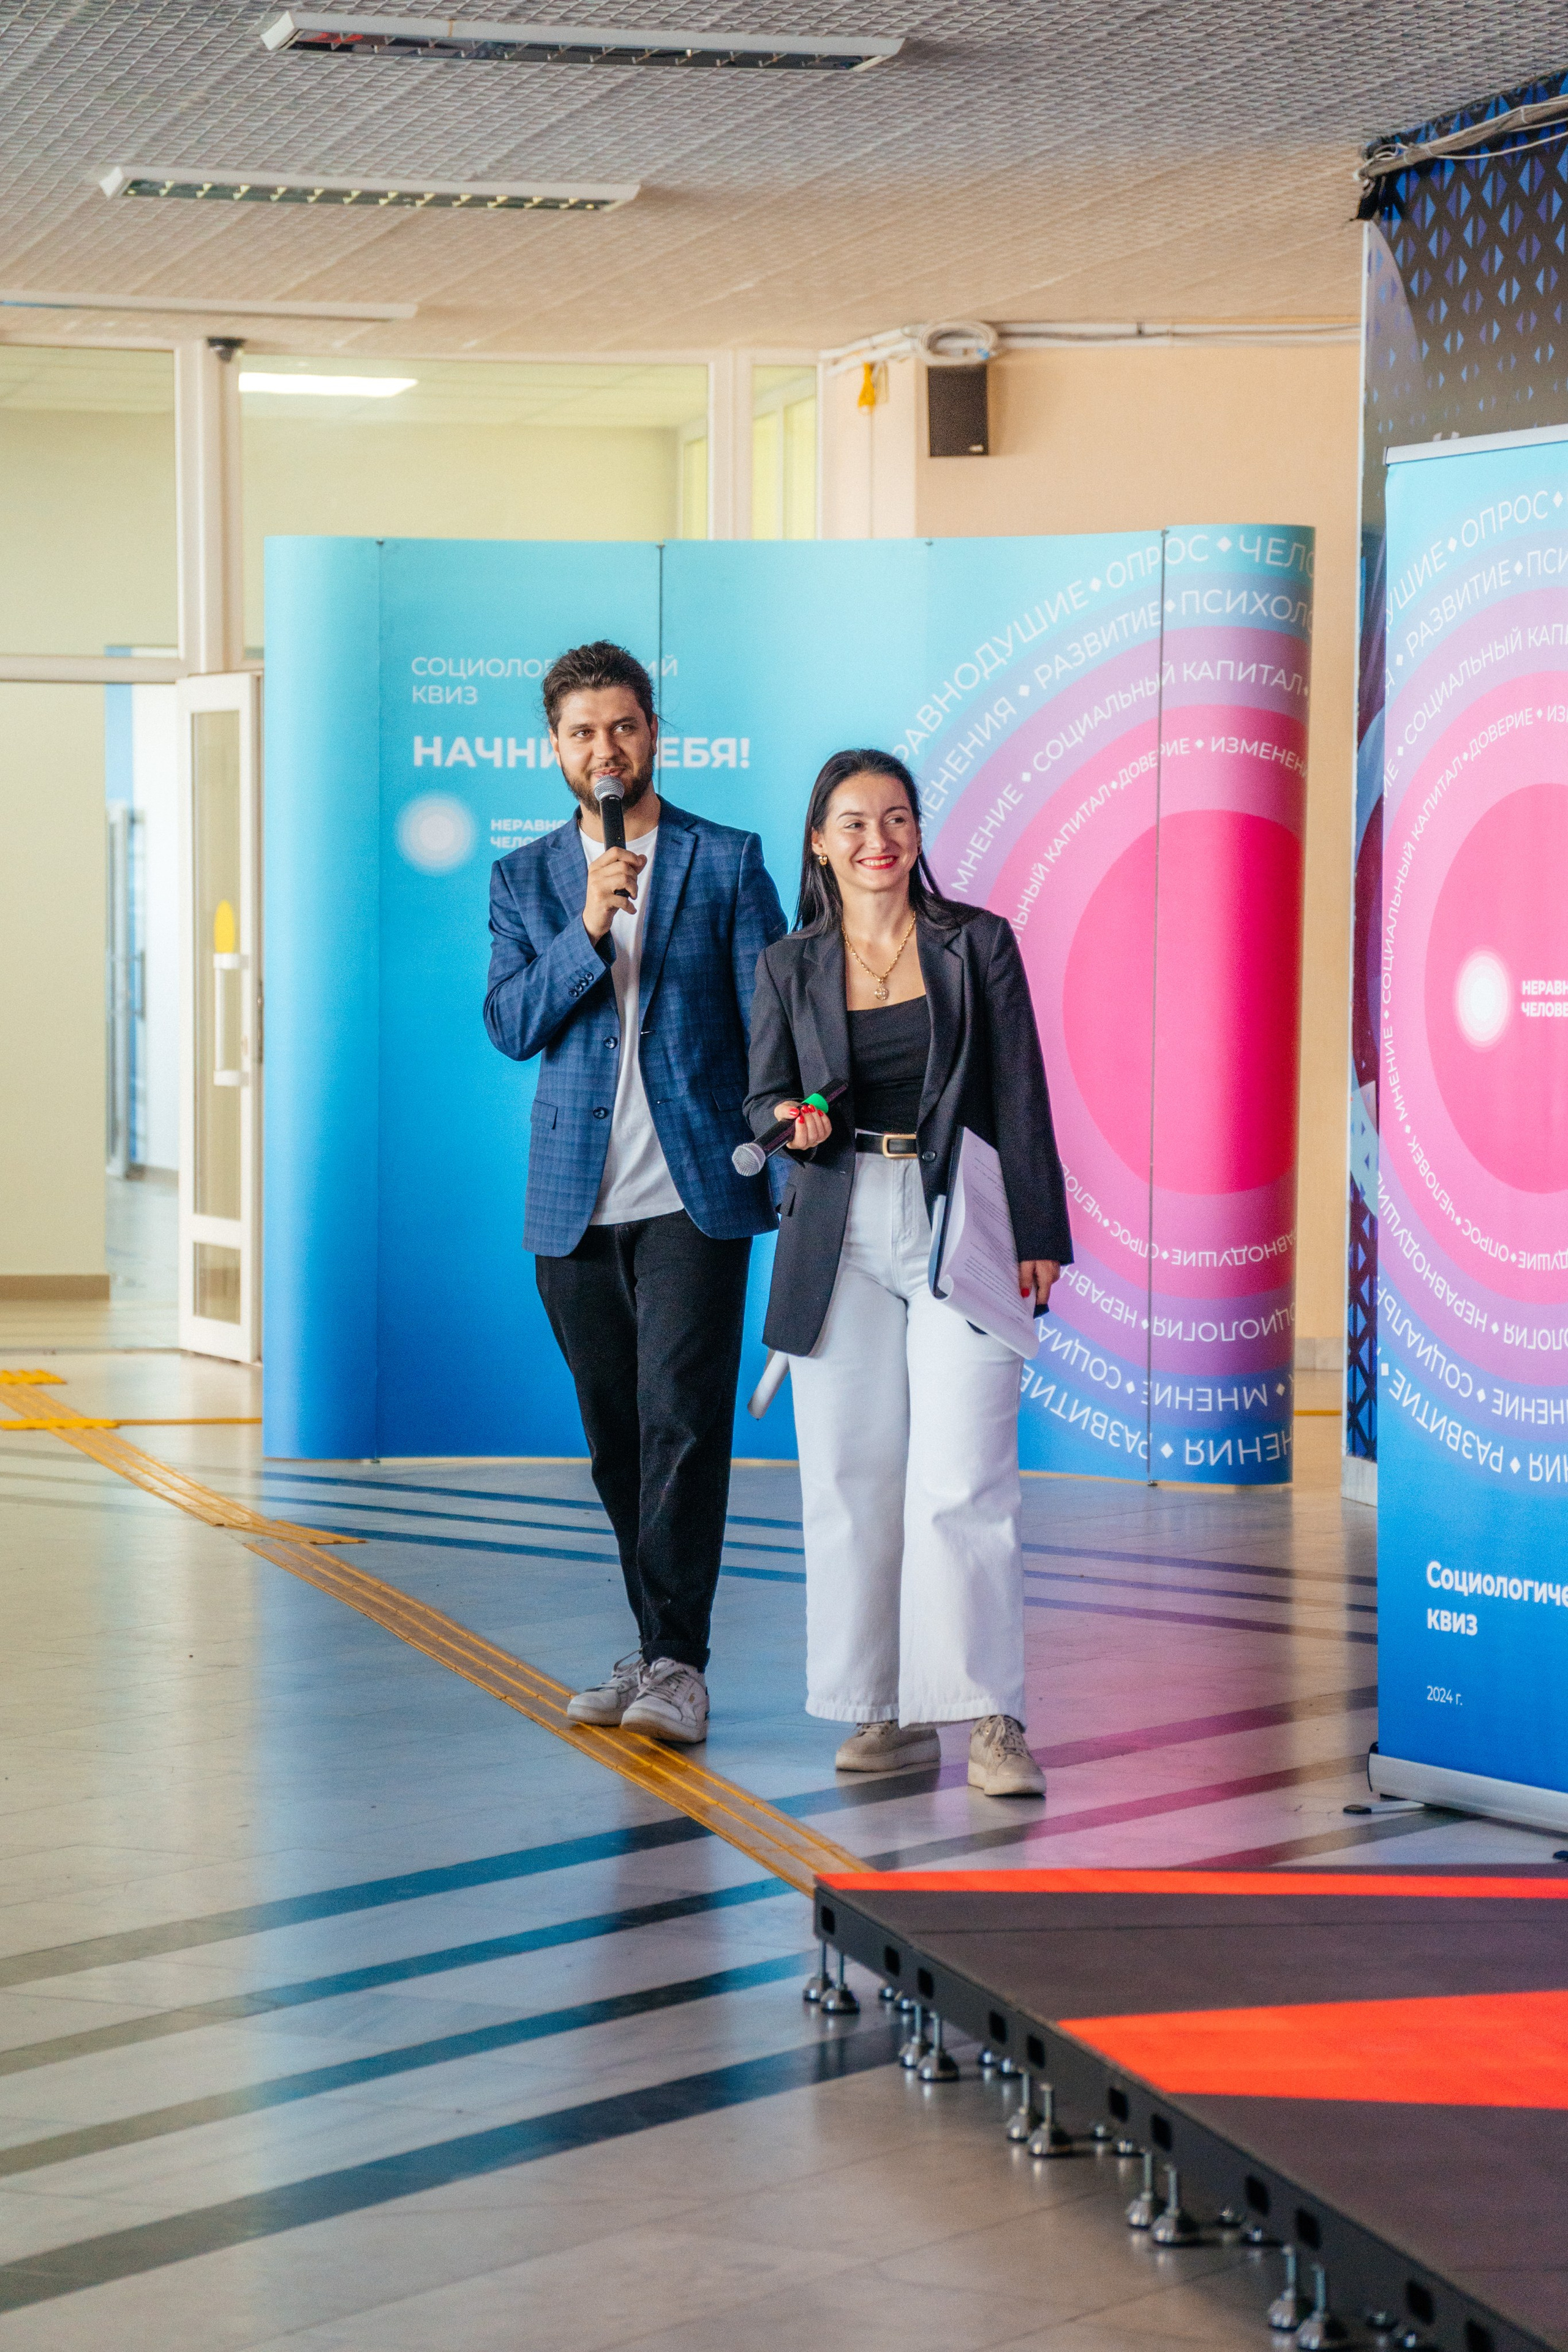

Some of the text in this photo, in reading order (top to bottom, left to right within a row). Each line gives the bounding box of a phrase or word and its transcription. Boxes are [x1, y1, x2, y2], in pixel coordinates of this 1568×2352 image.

[1106, 534, 1209, 590] ОПРОС
[1461, 491, 1548, 548] ОПРОС
[1033, 600, 1162, 690] РАЗВИТИЕ
[1406, 559, 1511, 658] РАЗВИТИЕ
[412, 685, 478, 706] КВИЗ
[1404, 626, 1523, 745] СОЦИАЛЬНЫЙ
[951, 660, 1303, 893] МНЕНИЕ СОЦИАЛЬНЫЙ КАПИТАЛ
[1044, 783, 1112, 864] КАПИТАЛ
[1118, 737, 1191, 790] ДОВЕРИЕ
[1382, 841, 1416, 1005] СОЦИАЛЬНЫЙ
[1411, 756, 1463, 842] КАПИТАЛ
[1469, 707, 1534, 761] ДОВЕРИЕ
[1383, 1025, 1408, 1122] МНЕНИЕ
[1408, 1136, 1456, 1221] ЧЕЛОВЕК
[1110, 1221, 1159, 1259] ОПРОС
[1461, 1218, 1509, 1262] ОПРОС
[1140, 1380, 1268, 1412] МНЕНИЕ
[1389, 1368, 1504, 1474] РАЗВИТИЕ
[1427, 1685, 1463, 1706] 2024 г.
